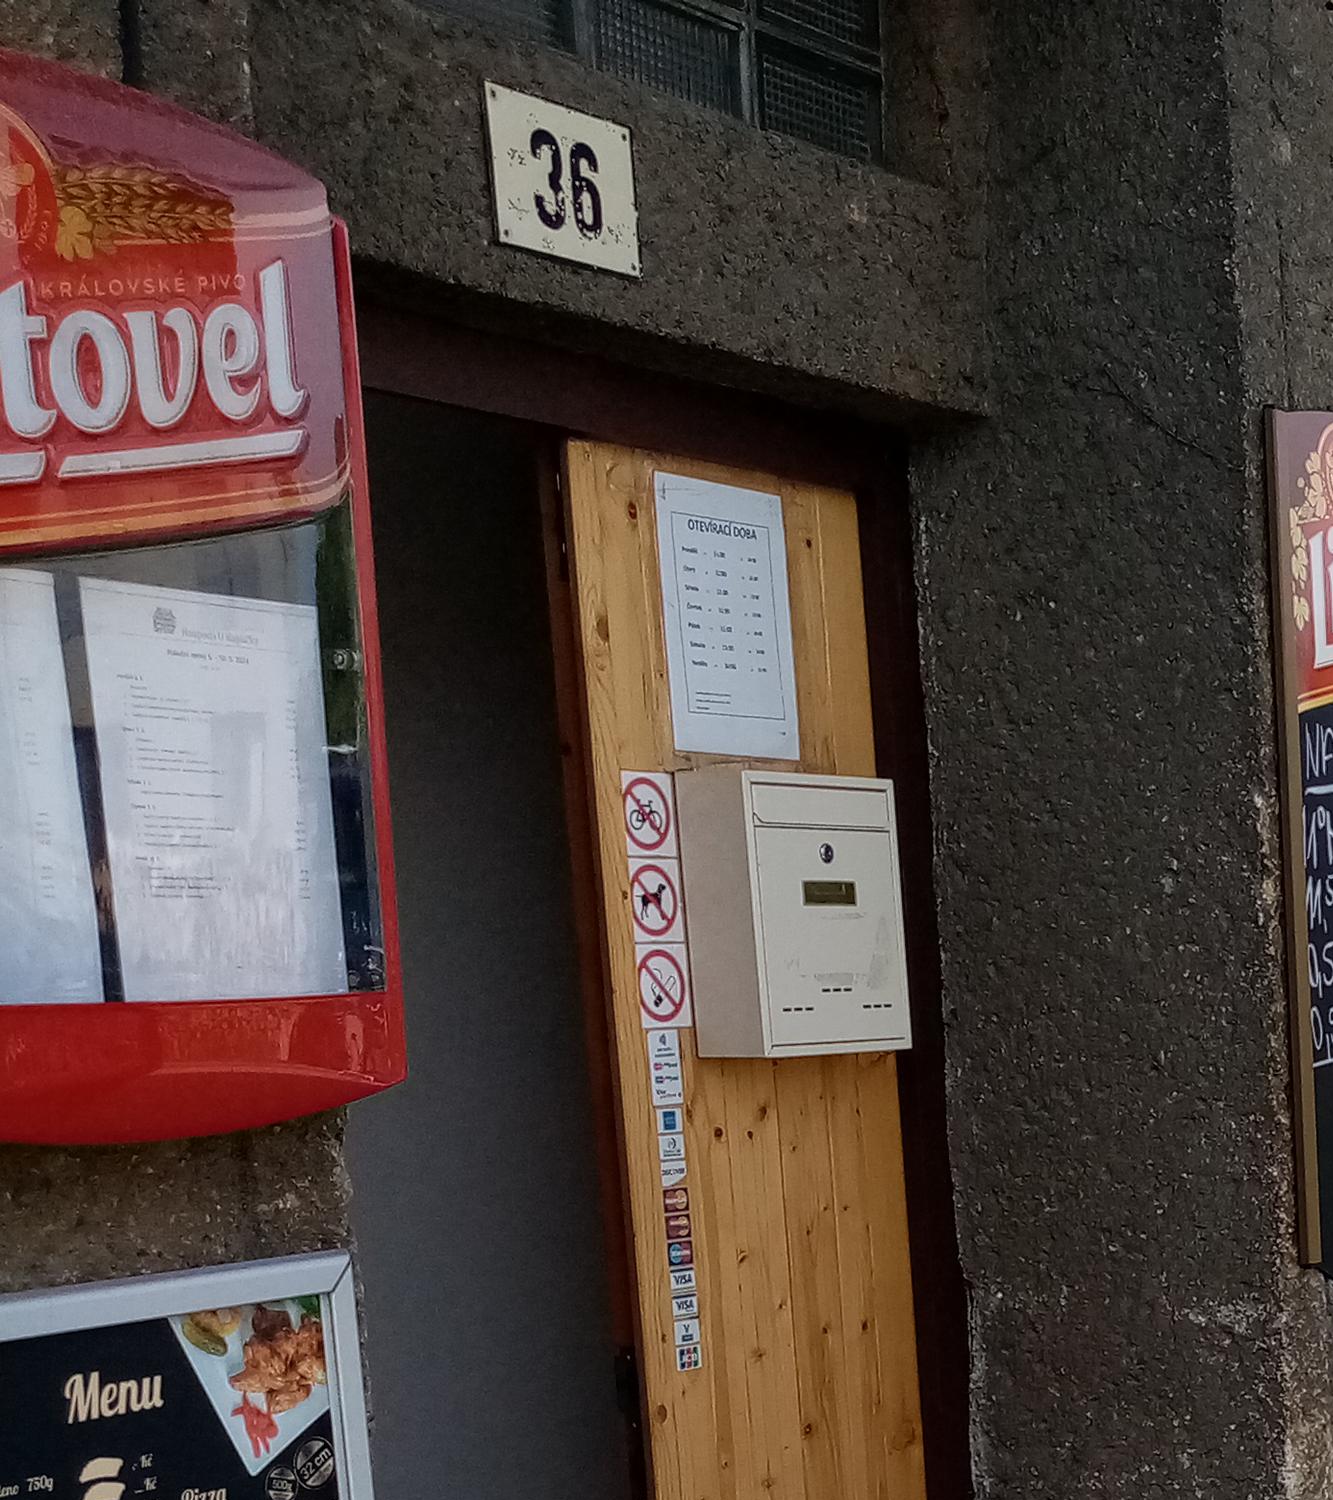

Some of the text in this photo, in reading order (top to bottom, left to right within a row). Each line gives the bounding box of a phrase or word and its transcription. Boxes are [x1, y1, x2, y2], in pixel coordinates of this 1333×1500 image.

[530, 128, 603, 241] 36
[40, 271, 246, 298] KRÁLOVSKÉ PIVO
[0, 259, 306, 438] tovel
[687, 518, 758, 541] OTEVÍRACÍ DOBA
[673, 1273, 692, 1286] VISA
[675, 1299, 694, 1311] VISA
[64, 1370, 164, 1425] Menu
[300, 1448, 332, 1480] 32 cm
[27, 1475, 54, 1492] 750g
